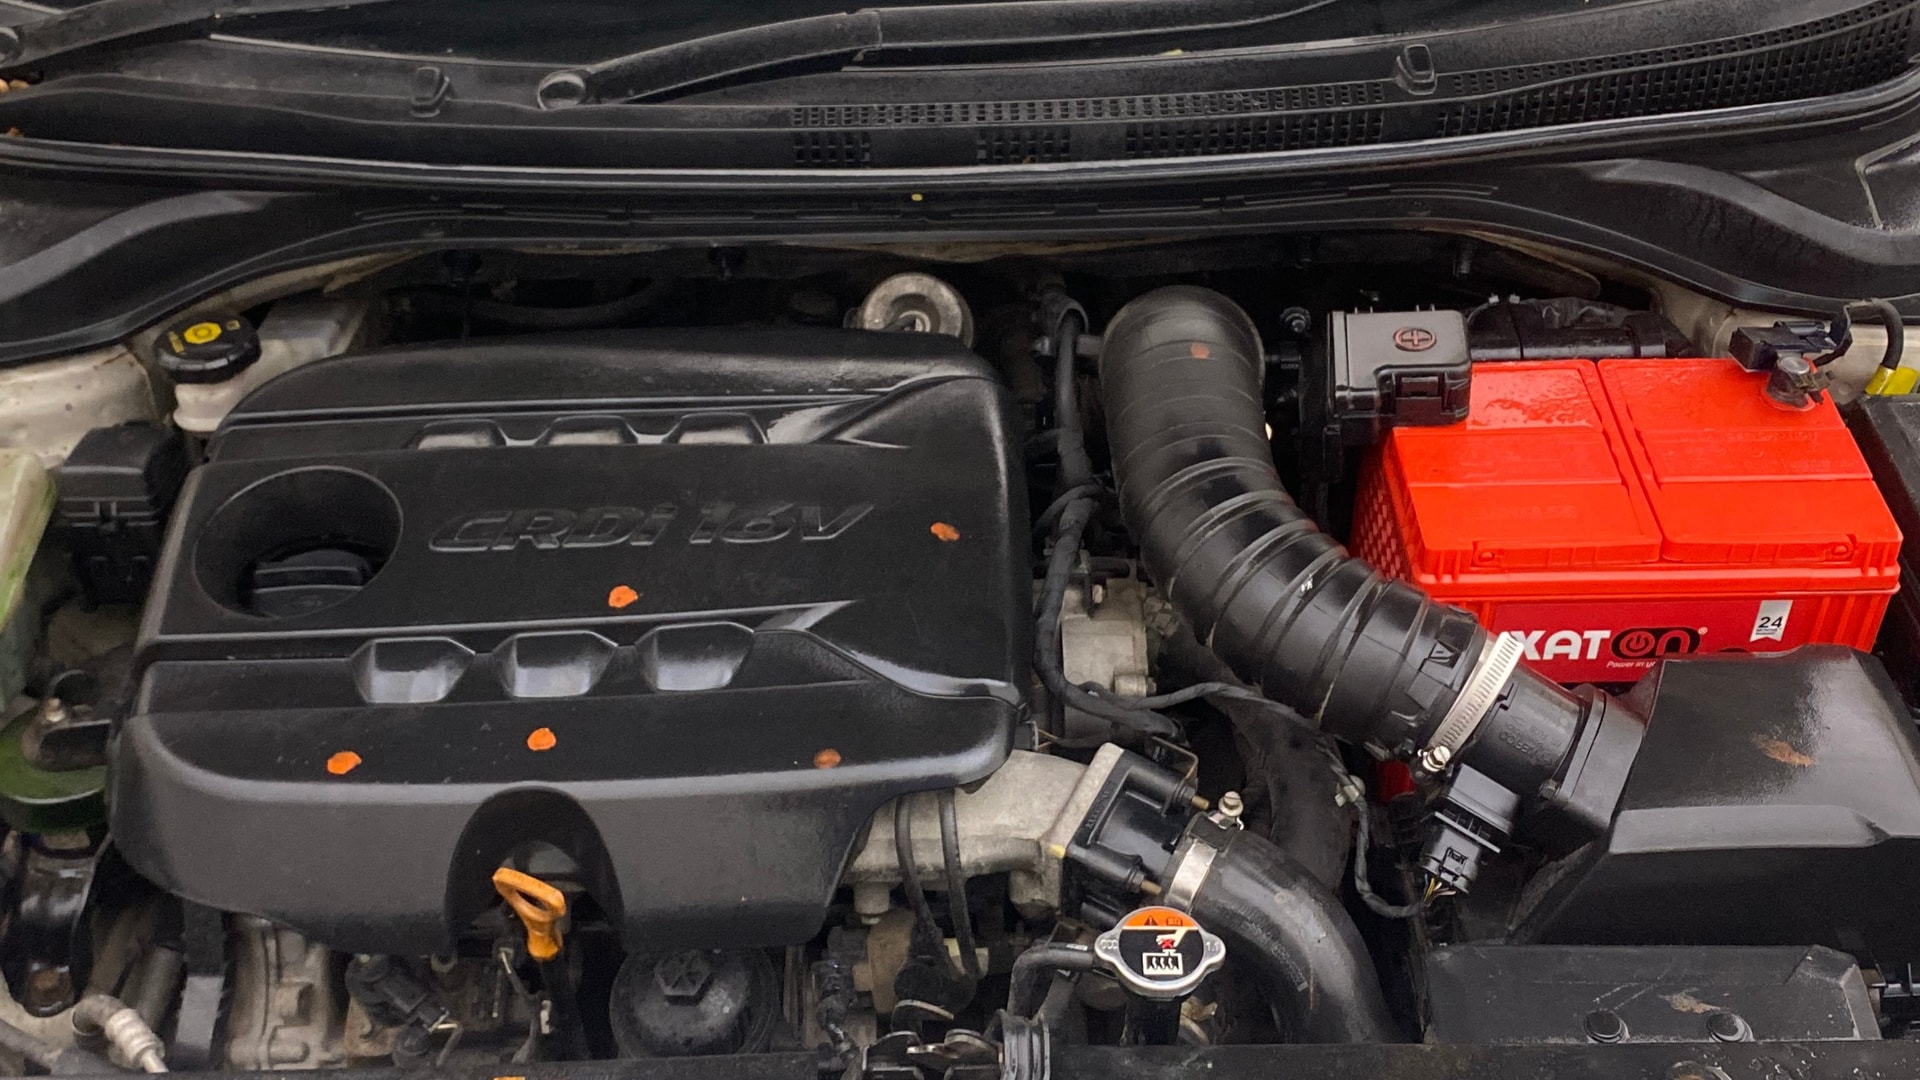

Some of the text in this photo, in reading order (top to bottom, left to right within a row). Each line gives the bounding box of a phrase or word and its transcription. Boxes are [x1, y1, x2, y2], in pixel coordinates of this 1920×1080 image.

[428, 501, 876, 552] CRDi 16V
[1758, 616, 1783, 628] 24
